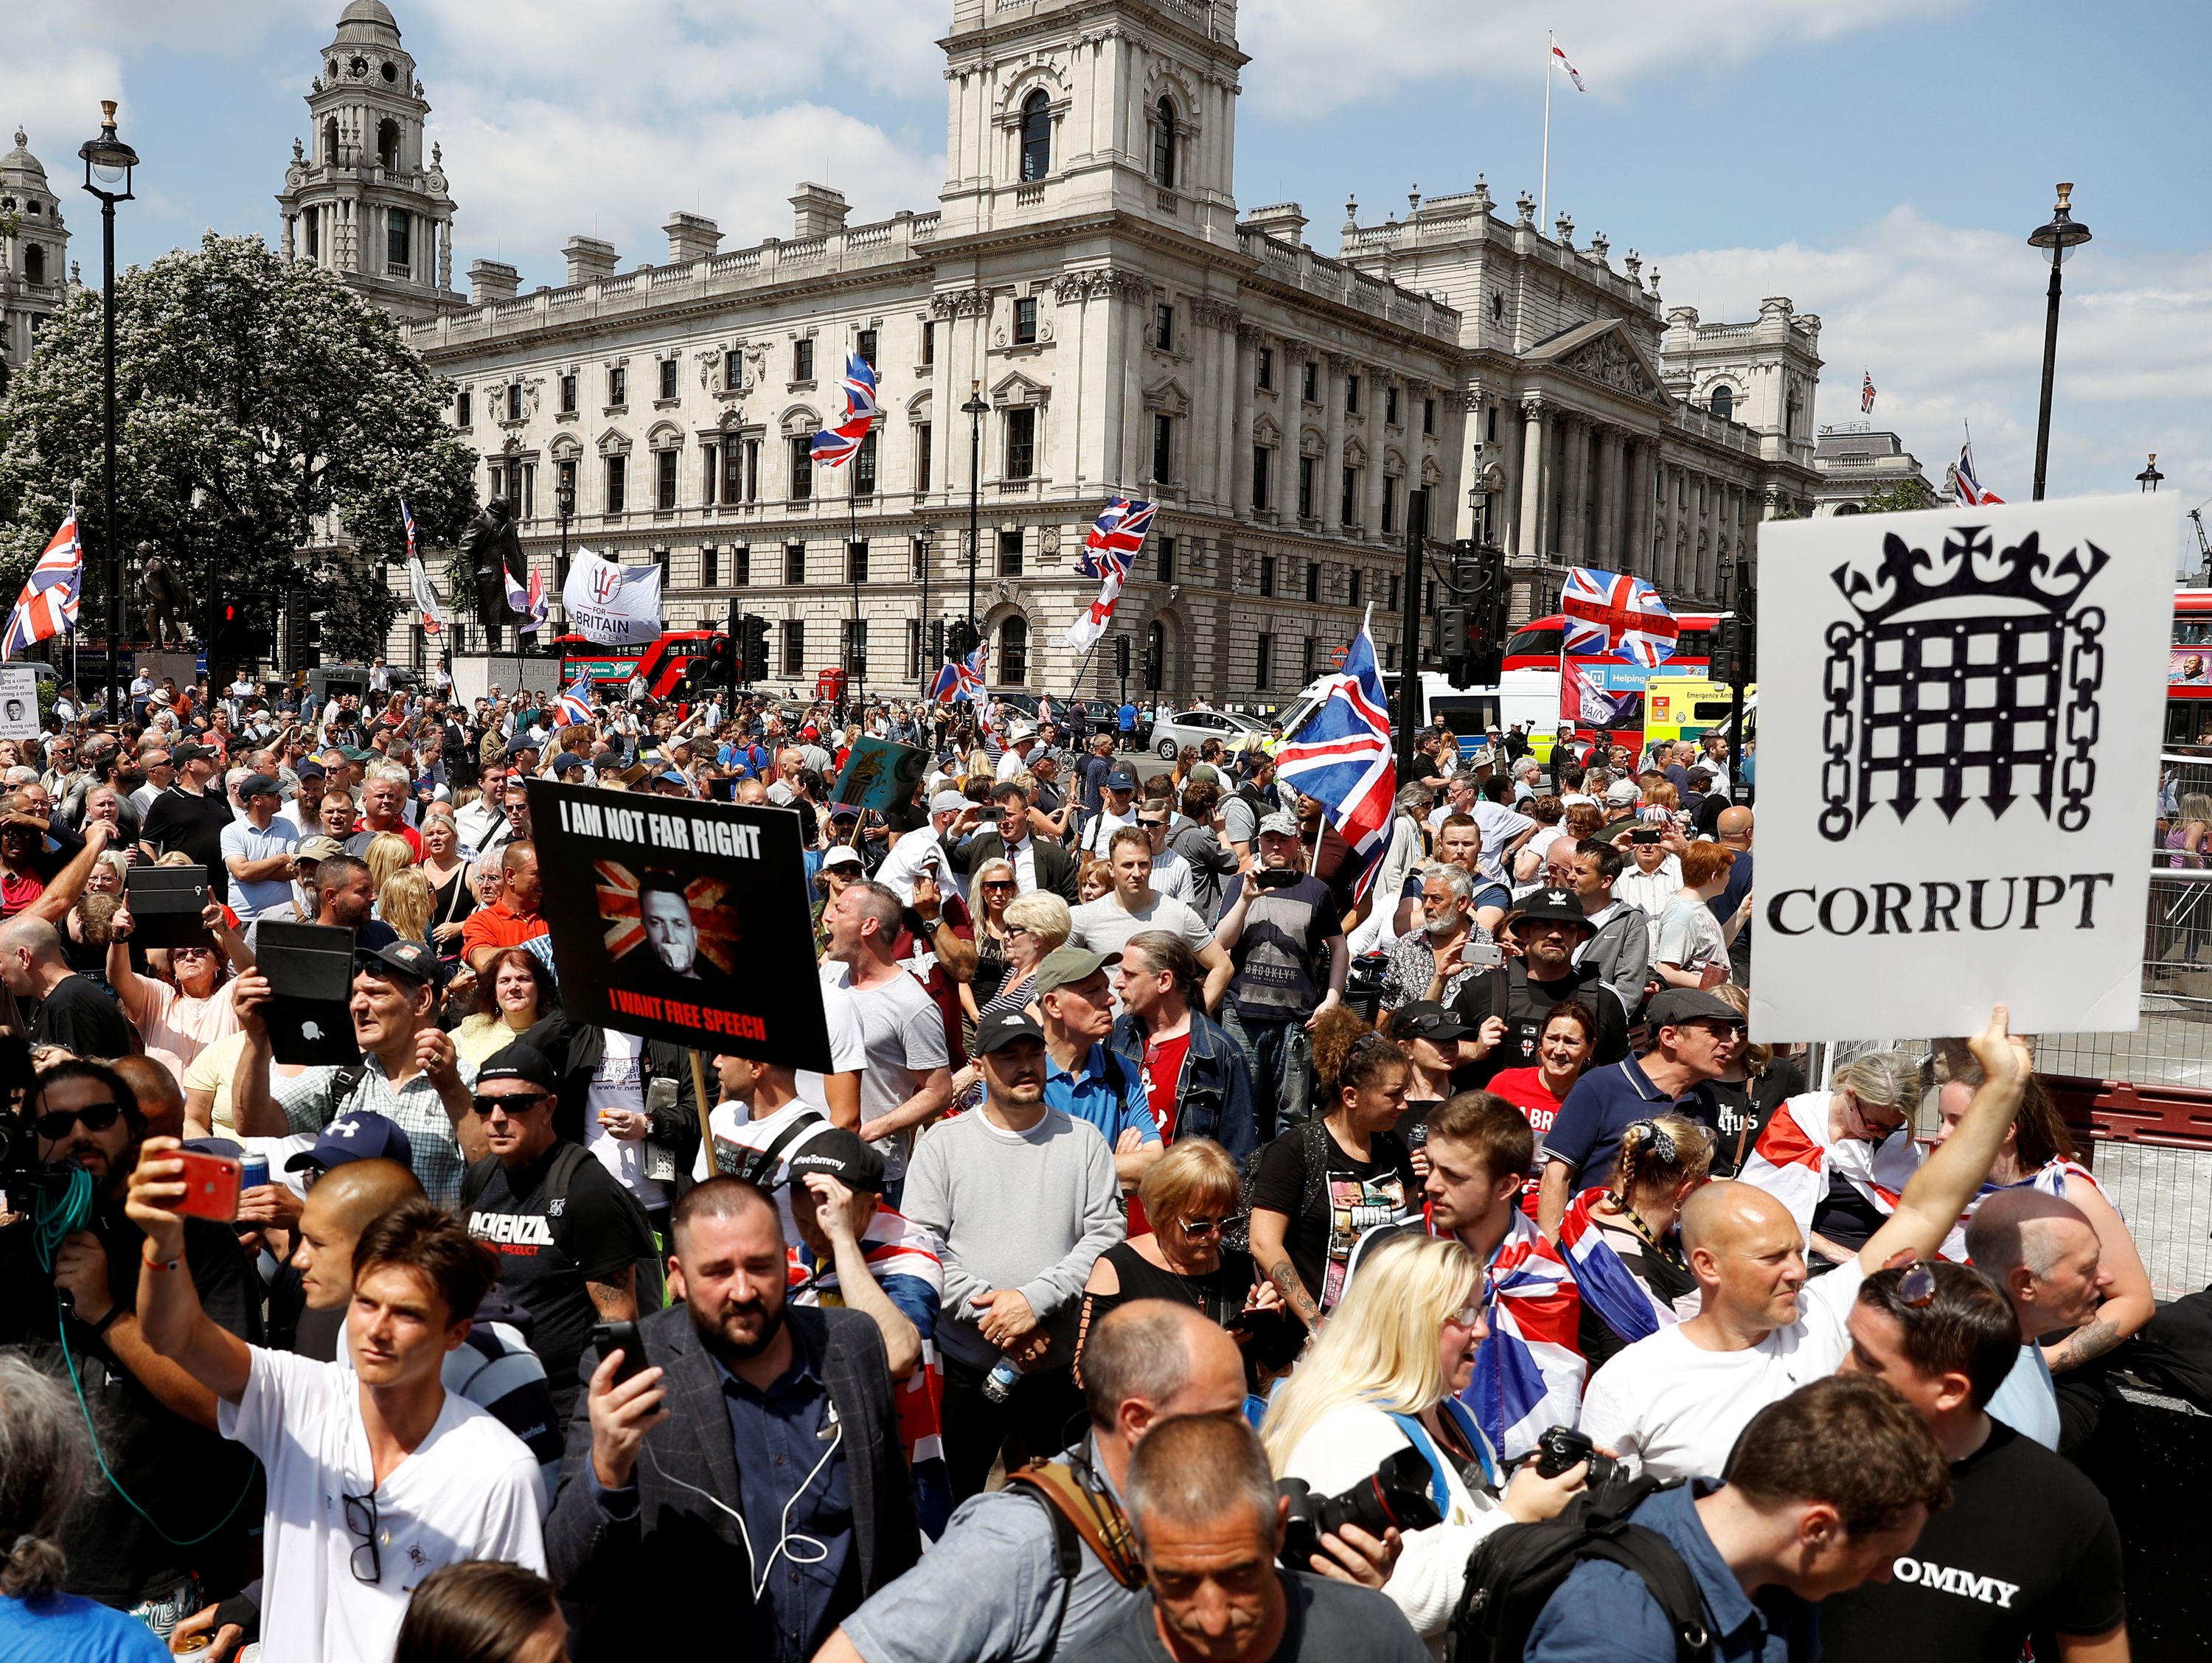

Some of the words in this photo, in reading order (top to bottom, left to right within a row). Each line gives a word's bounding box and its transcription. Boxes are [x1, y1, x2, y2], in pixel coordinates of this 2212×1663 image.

[593, 606, 606, 616] FOR
[576, 610, 630, 634] BRITAIN
[490, 664, 558, 677] CHURCHILL
[1613, 674, 1646, 683] Helping
[559, 800, 569, 832] I
[571, 801, 604, 837] AM
[604, 806, 645, 844] NOT
[647, 813, 690, 851] FAR
[691, 818, 761, 860] RIGHT
[1765, 873, 2115, 937] CORRUPT
[1245, 963, 1298, 980] BROOKLYN
[608, 988, 617, 1011] I
[616, 989, 663, 1021] WANT
[664, 999, 703, 1029] FREE
[702, 1007, 768, 1042] SPEECH
[1719, 1104, 1734, 1115] THE
[501, 1244, 540, 1255] PRODUCT
[1892, 1556, 2021, 1609] OMMY
